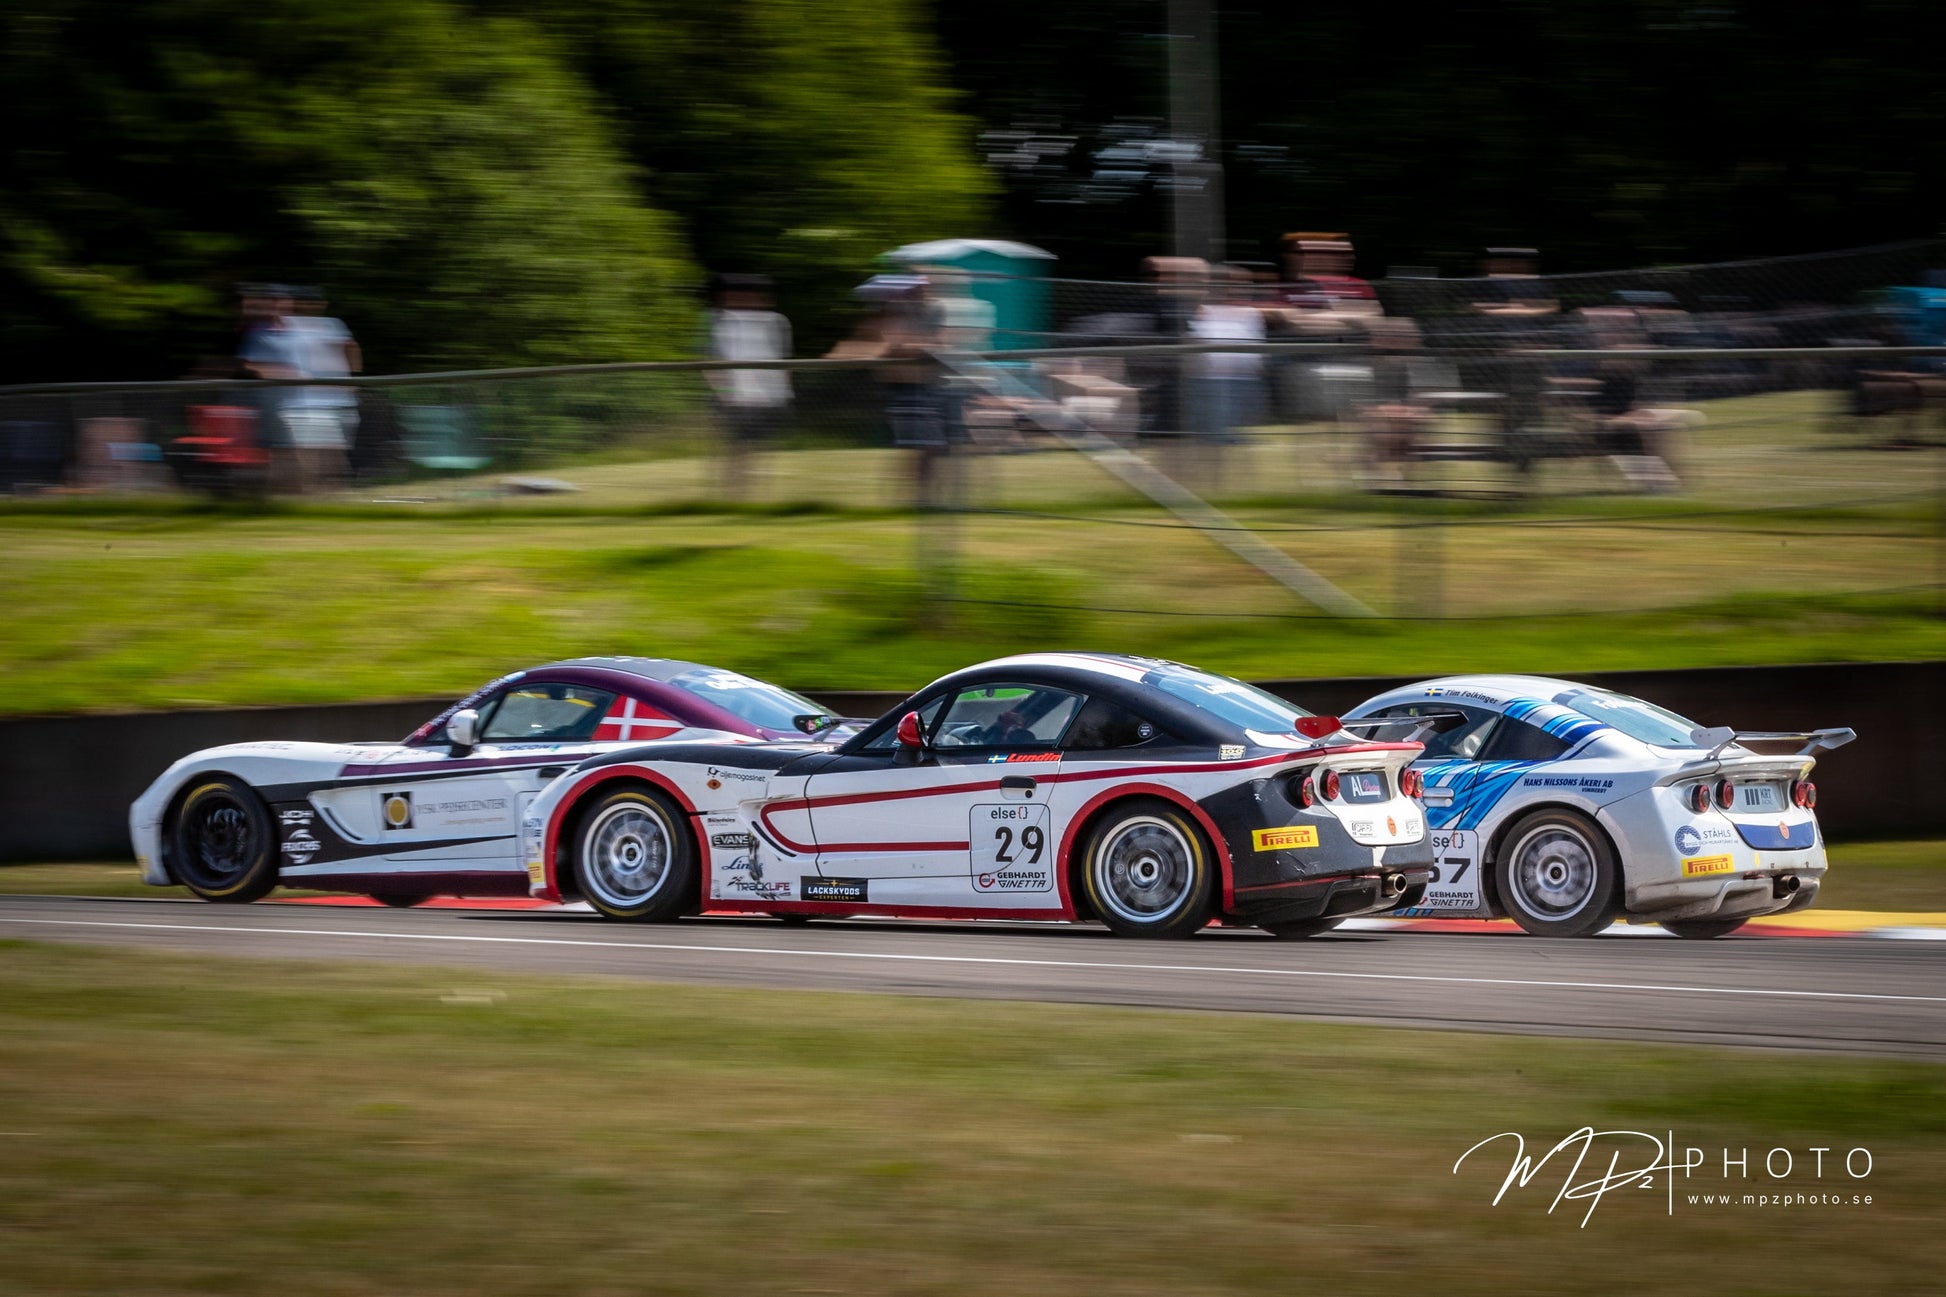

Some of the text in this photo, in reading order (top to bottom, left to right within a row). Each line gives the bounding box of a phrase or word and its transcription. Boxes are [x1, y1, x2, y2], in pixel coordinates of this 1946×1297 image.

[1461, 691, 1498, 704] Folkinger
[1007, 753, 1060, 762] Lundin
[1524, 777, 1613, 788] HANS NILSSONS ÅKERI AB
[1261, 830, 1310, 846] PIRELLI
[1703, 827, 1731, 838] STÅHLS
[713, 835, 750, 845] EVANS
[995, 826, 1044, 864] 29
[1432, 833, 1465, 848] se{}
[1688, 857, 1729, 874] PIRELLI
[998, 880, 1046, 888] GINETTA
[808, 886, 860, 896] LACKSKYDDS
[1429, 891, 1473, 899] GEBHARDT
[1430, 899, 1474, 907] GINETTA
